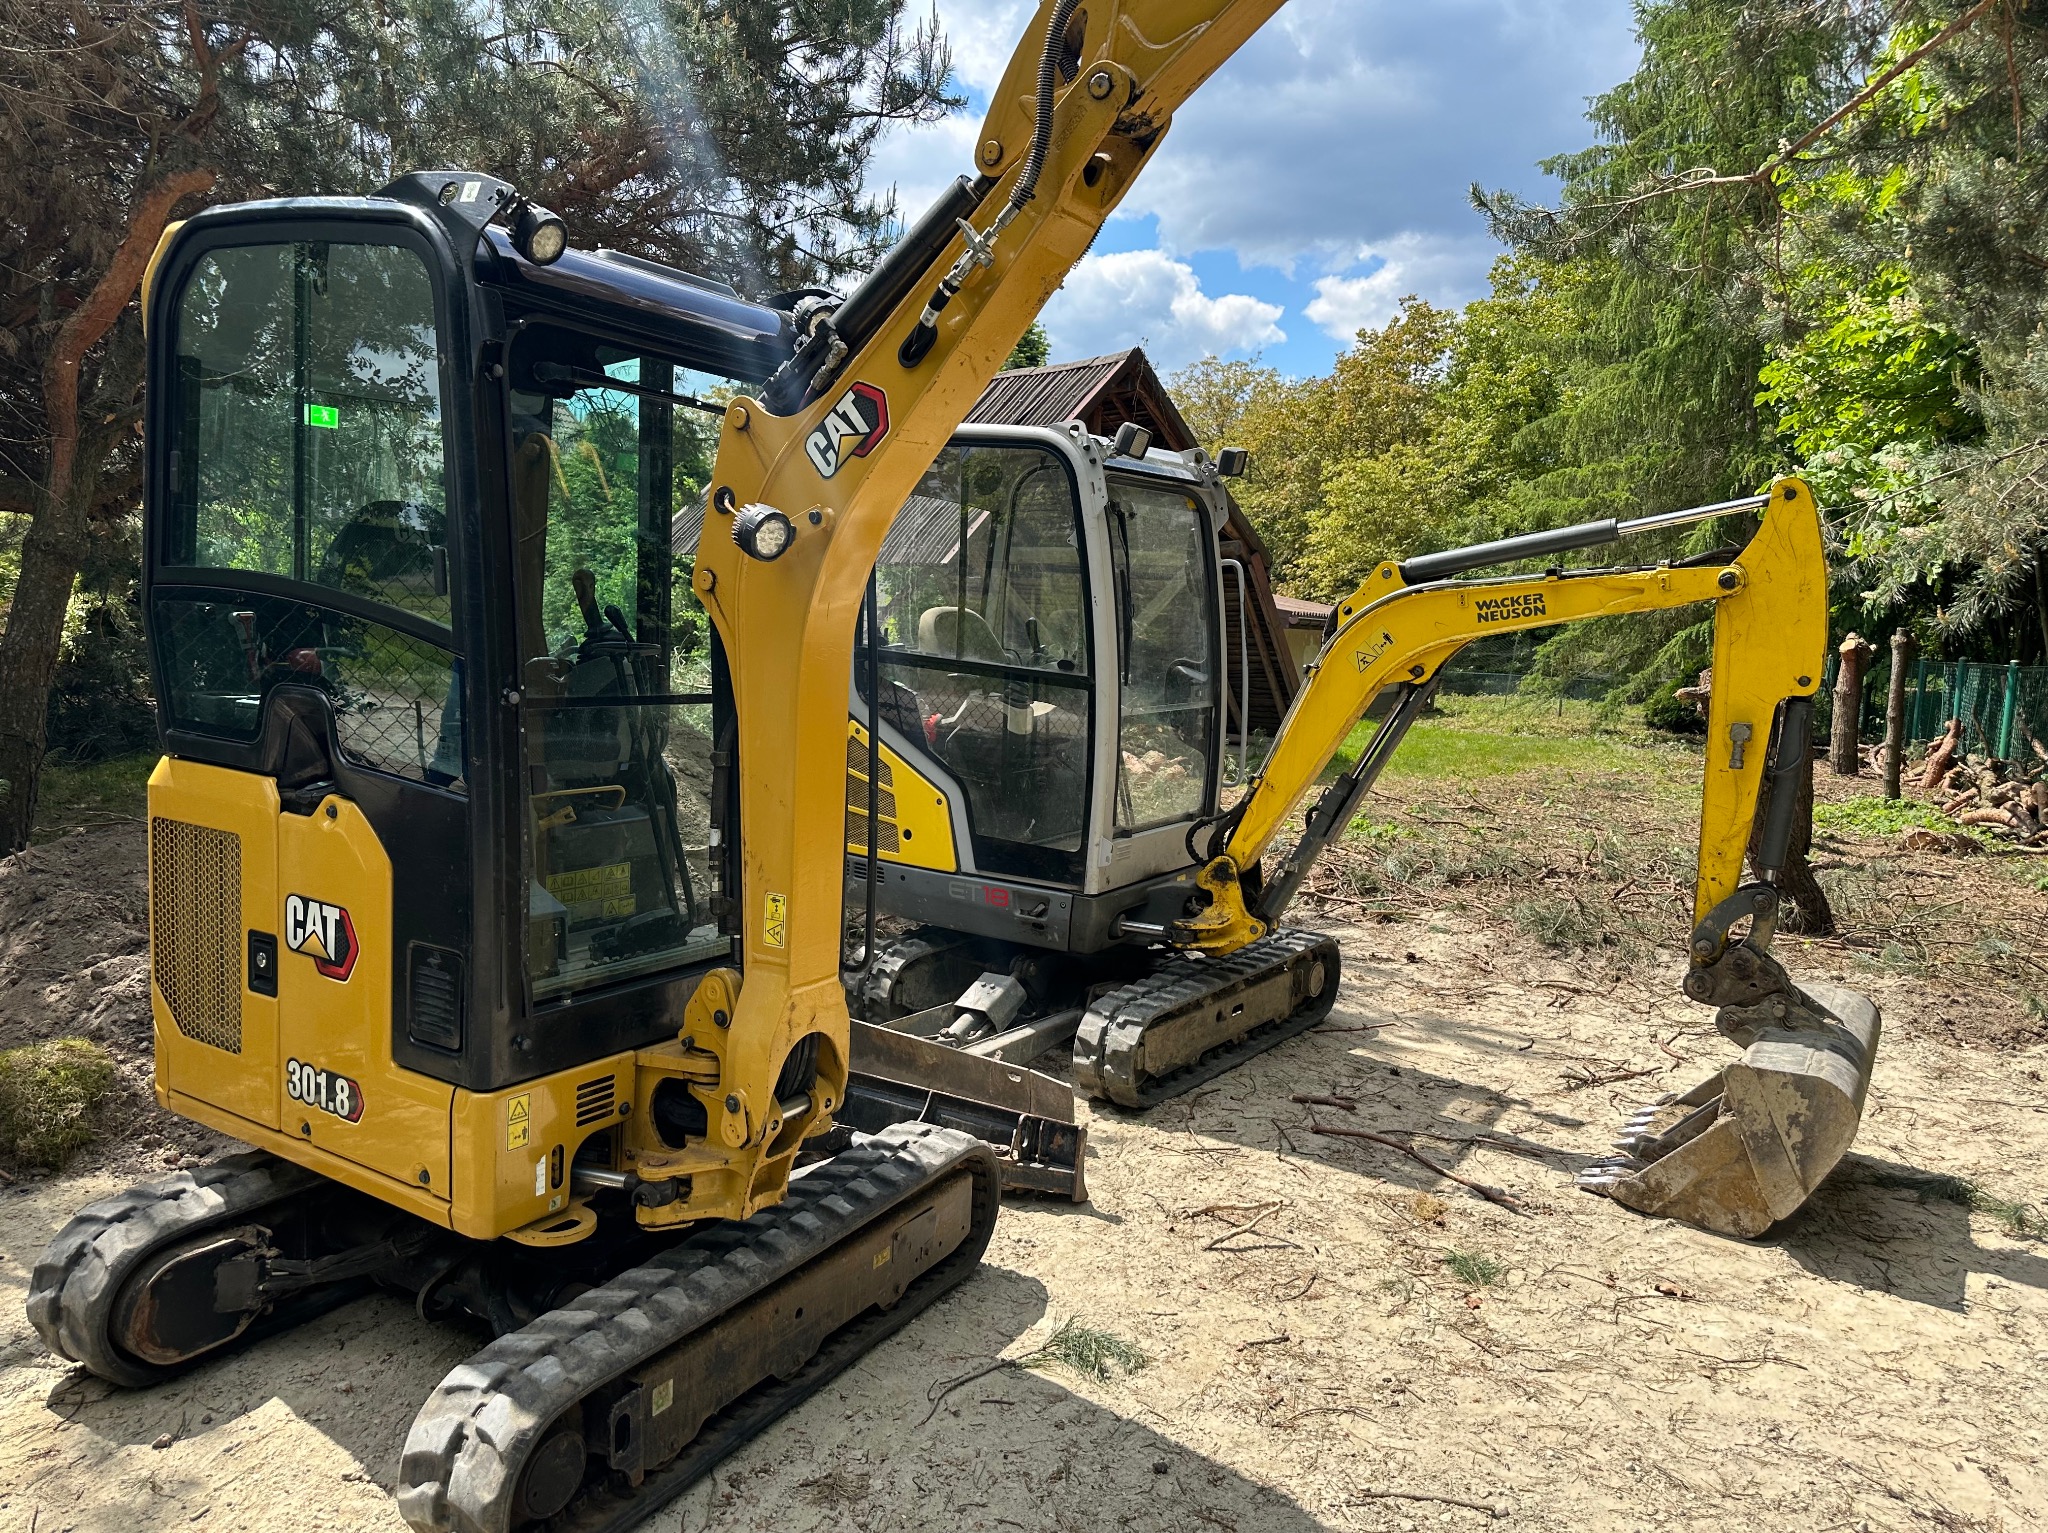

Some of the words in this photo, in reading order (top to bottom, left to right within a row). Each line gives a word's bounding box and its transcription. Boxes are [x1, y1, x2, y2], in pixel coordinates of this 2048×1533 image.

[806, 390, 871, 477] CAT
[1475, 593, 1545, 611] WACKER
[1477, 605, 1546, 623] NEUSON
[949, 881, 1009, 907] ET18
[286, 895, 340, 961] CAT
[288, 1060, 349, 1116] 301.8
